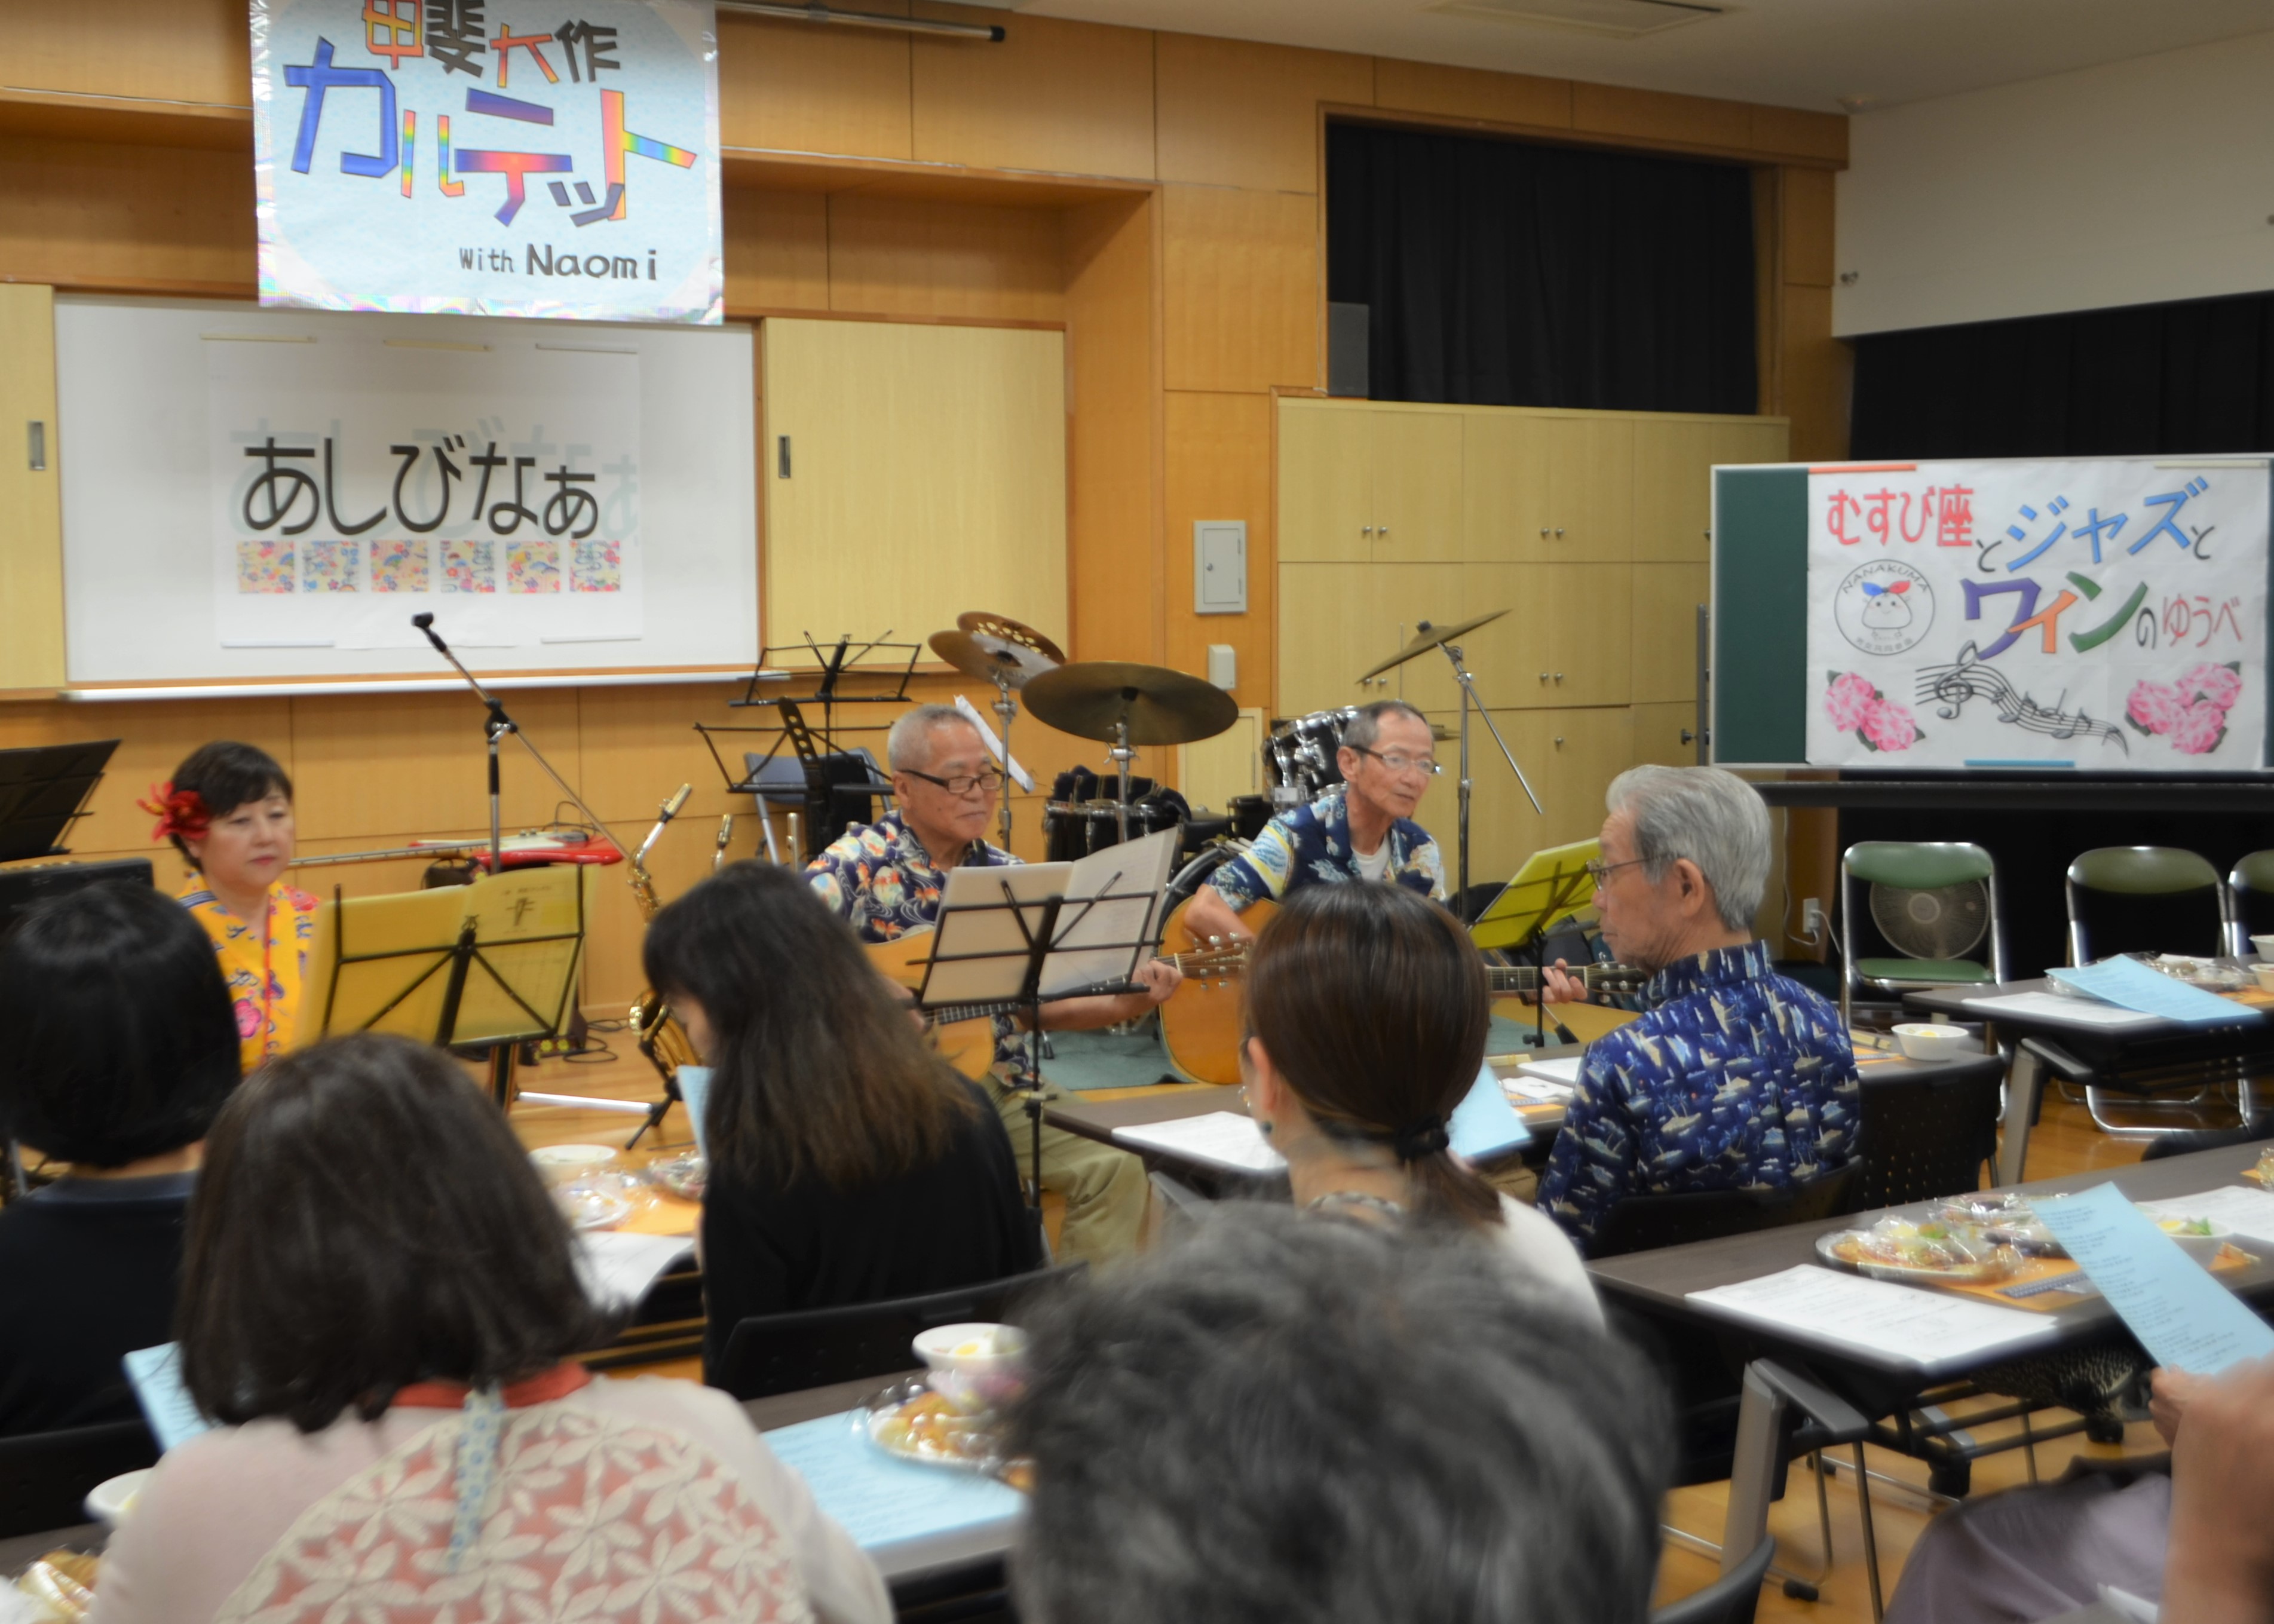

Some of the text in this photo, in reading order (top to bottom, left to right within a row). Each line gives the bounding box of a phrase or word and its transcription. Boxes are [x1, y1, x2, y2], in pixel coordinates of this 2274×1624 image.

[361, 0, 621, 88] 甲斐大作
[283, 36, 697, 227] カルテット
[526, 243, 657, 280] Naomi
[1843, 564, 1928, 595] NANAKUMA
